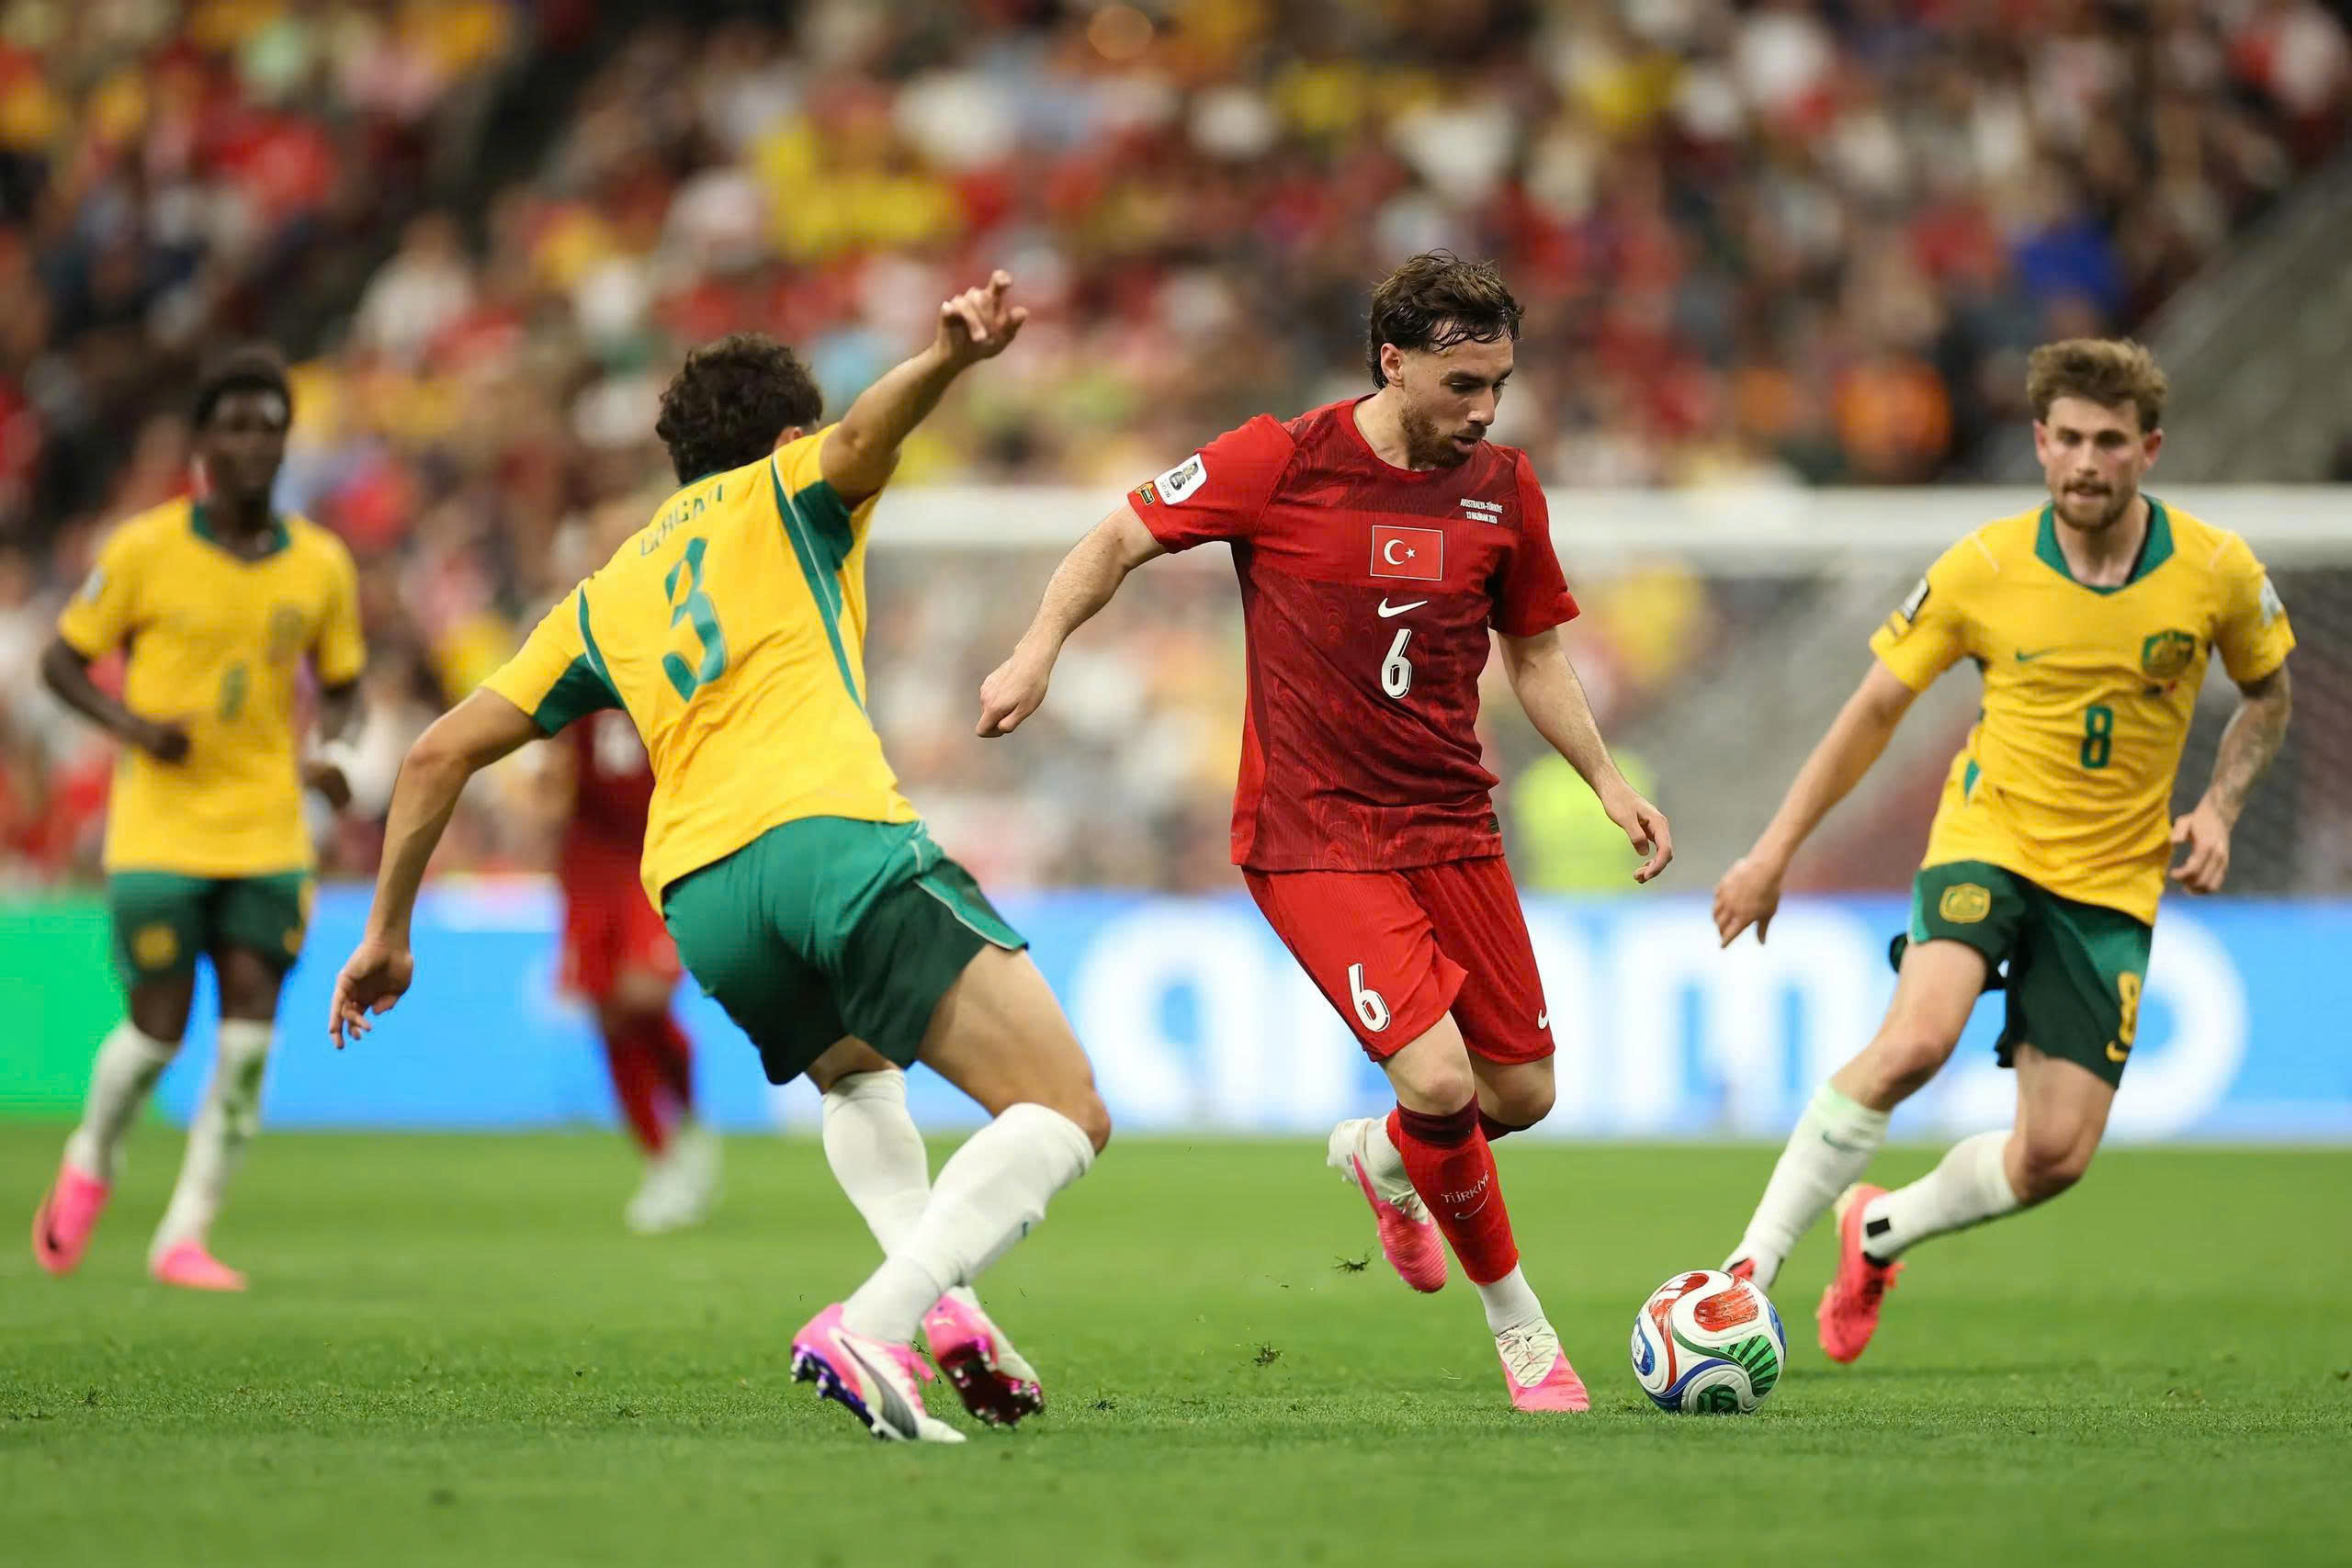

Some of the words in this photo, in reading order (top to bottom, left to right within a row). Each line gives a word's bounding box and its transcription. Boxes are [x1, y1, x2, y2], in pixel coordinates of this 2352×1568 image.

[662, 537, 727, 703] 3
[1381, 628, 1413, 699] 6
[2080, 705, 2114, 770] 8
[1071, 900, 2251, 1141] amo
[1347, 963, 1391, 1032] 6
[2117, 970, 2141, 1045] 8
